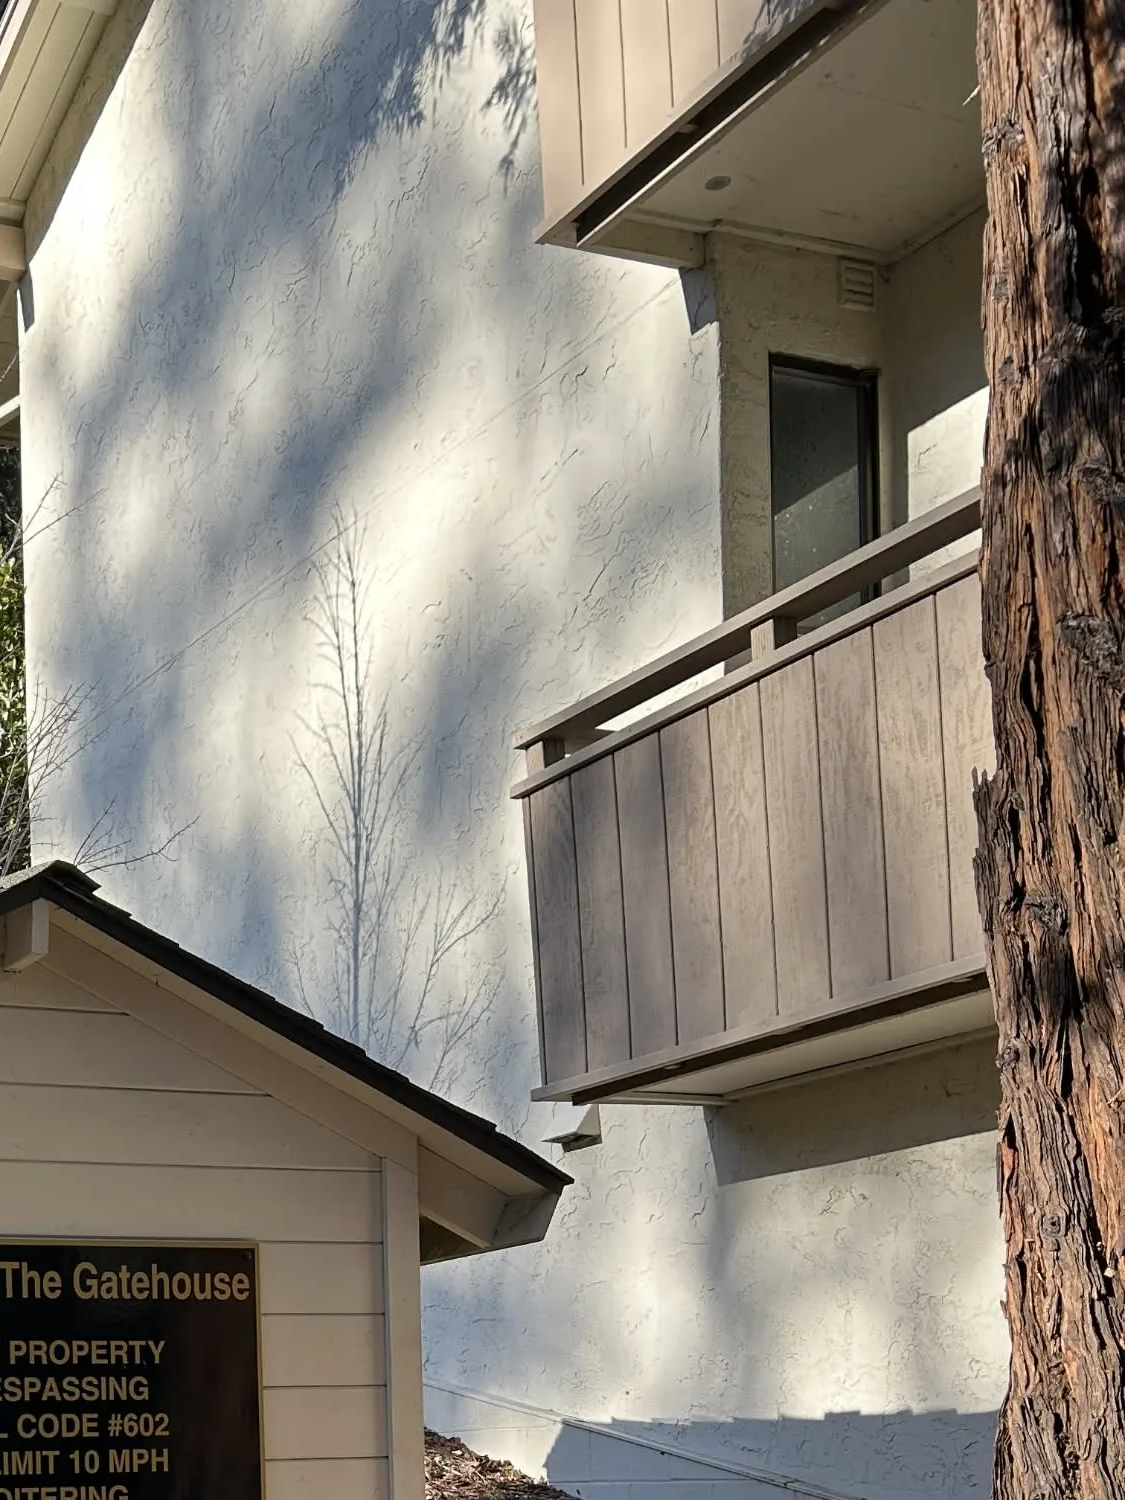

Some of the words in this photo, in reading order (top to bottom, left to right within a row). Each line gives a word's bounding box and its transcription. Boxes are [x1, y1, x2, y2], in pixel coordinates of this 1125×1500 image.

[73, 1261, 250, 1301] Gatehouse
[9, 1339, 166, 1365] PROPERTY
[17, 1413, 100, 1439] CODE
[107, 1412, 170, 1438] #602
[69, 1449, 100, 1474] 10
[108, 1448, 169, 1473] MPH
